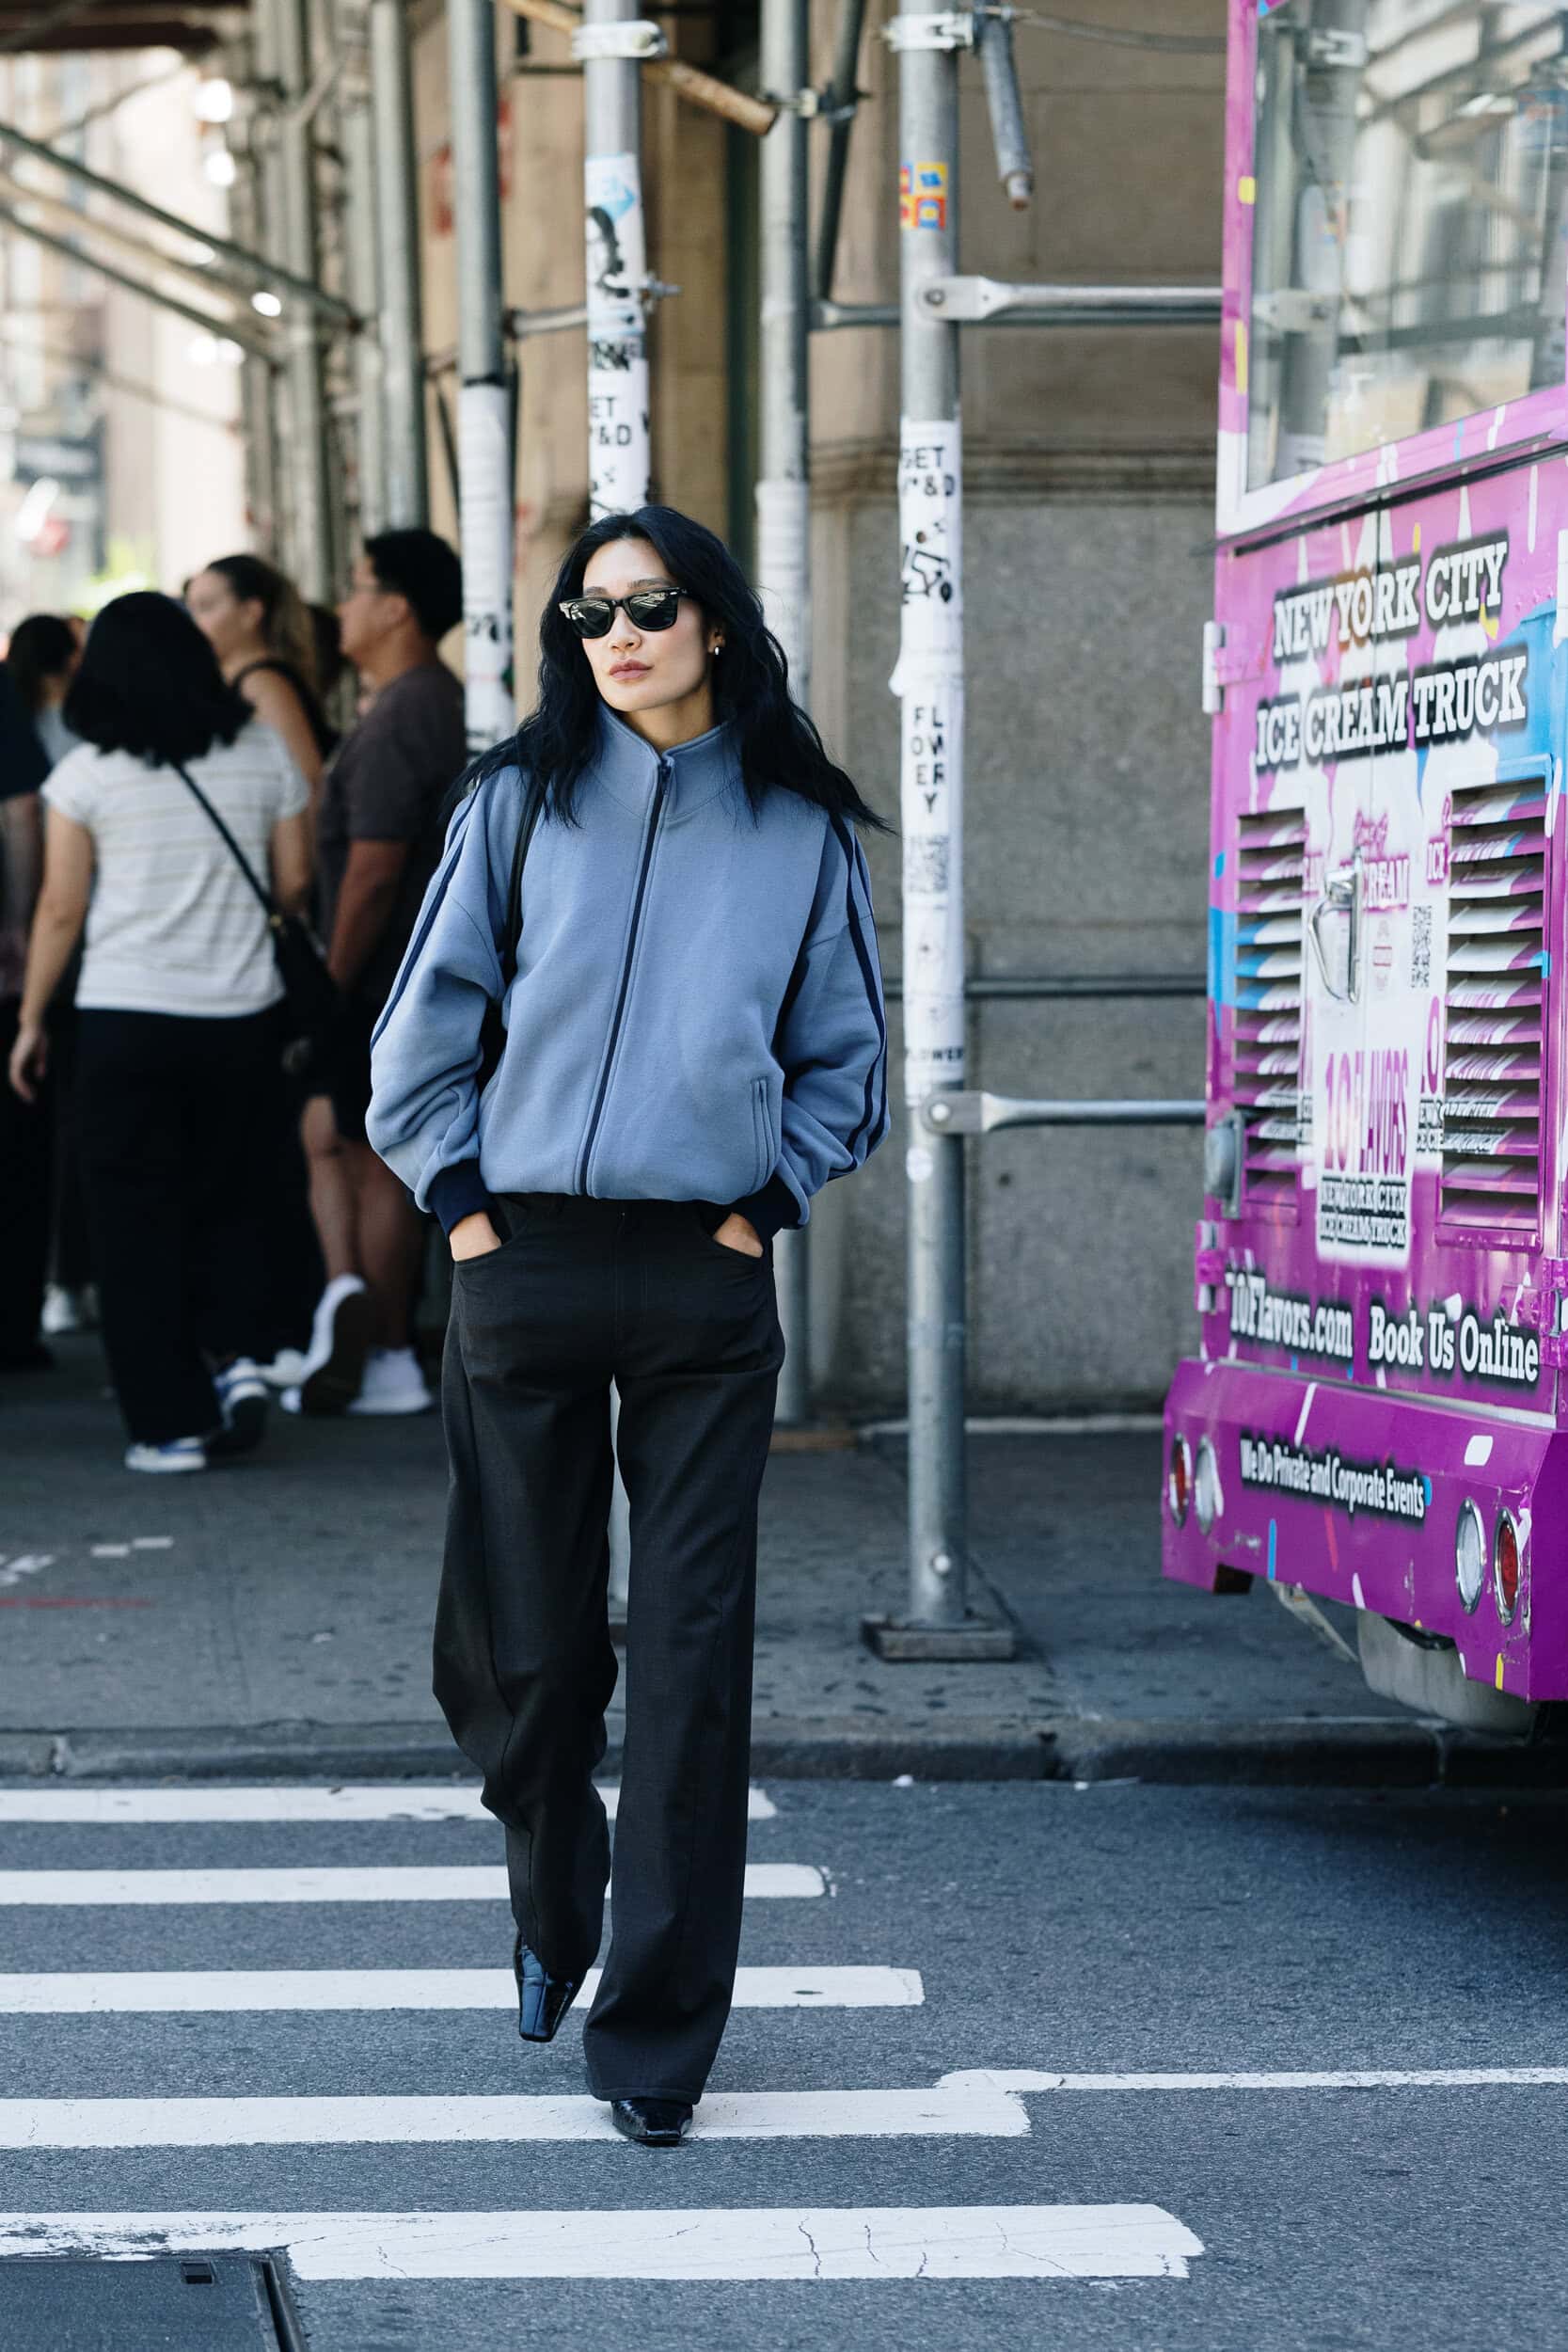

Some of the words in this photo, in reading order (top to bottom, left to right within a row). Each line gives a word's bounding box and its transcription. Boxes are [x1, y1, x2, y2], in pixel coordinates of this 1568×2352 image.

[1274, 587, 1336, 658] NEW
[1336, 564, 1421, 643] YORK
[1425, 542, 1508, 622] CITY
[1256, 704, 1300, 766] ICE
[1304, 680, 1409, 757] CREAM
[1413, 655, 1527, 739] TRUCK
[1370, 1217, 1406, 1245] TRUCK
[1377, 1184, 1406, 1214] CITY
[1369, 1305, 1424, 1366] Book
[1428, 1311, 1455, 1372] Us
[1459, 1314, 1540, 1383] Online
[1240, 1438, 1258, 1481] We
[1257, 1441, 1274, 1484] Do
[1273, 1443, 1310, 1493] Private
[1310, 1453, 1331, 1498] and
[1331, 1456, 1386, 1514] Corporate
[1386, 1468, 1425, 1519] Events
